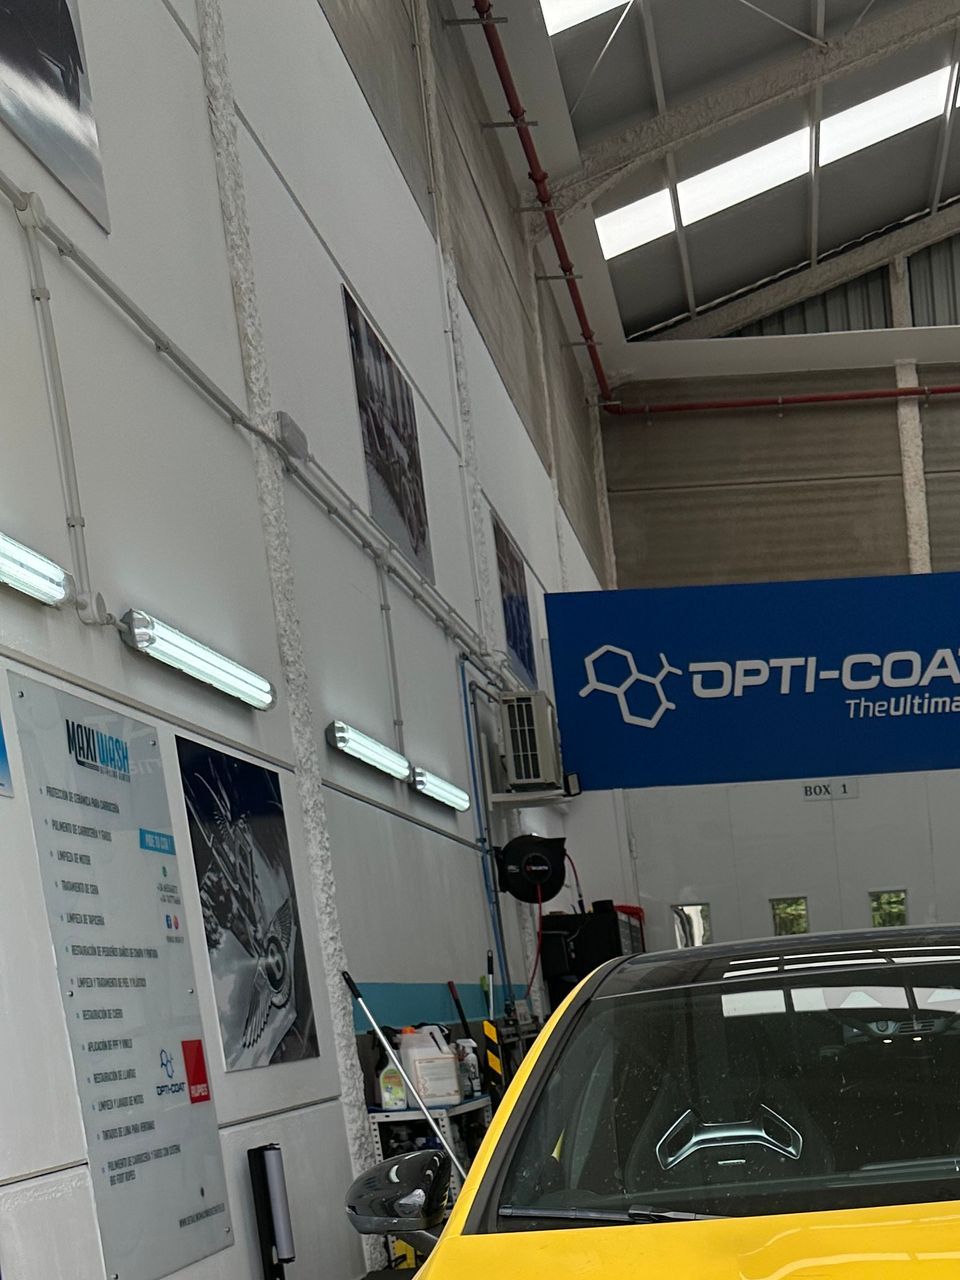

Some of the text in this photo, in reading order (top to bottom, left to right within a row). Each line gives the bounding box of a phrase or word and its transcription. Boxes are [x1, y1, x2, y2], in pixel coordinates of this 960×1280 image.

[65, 719, 130, 773] MAXI WASH
[804, 783, 848, 797] BOX 1
[156, 1082, 185, 1095] OPTI-COAT
[190, 1083, 208, 1098] RUPES
